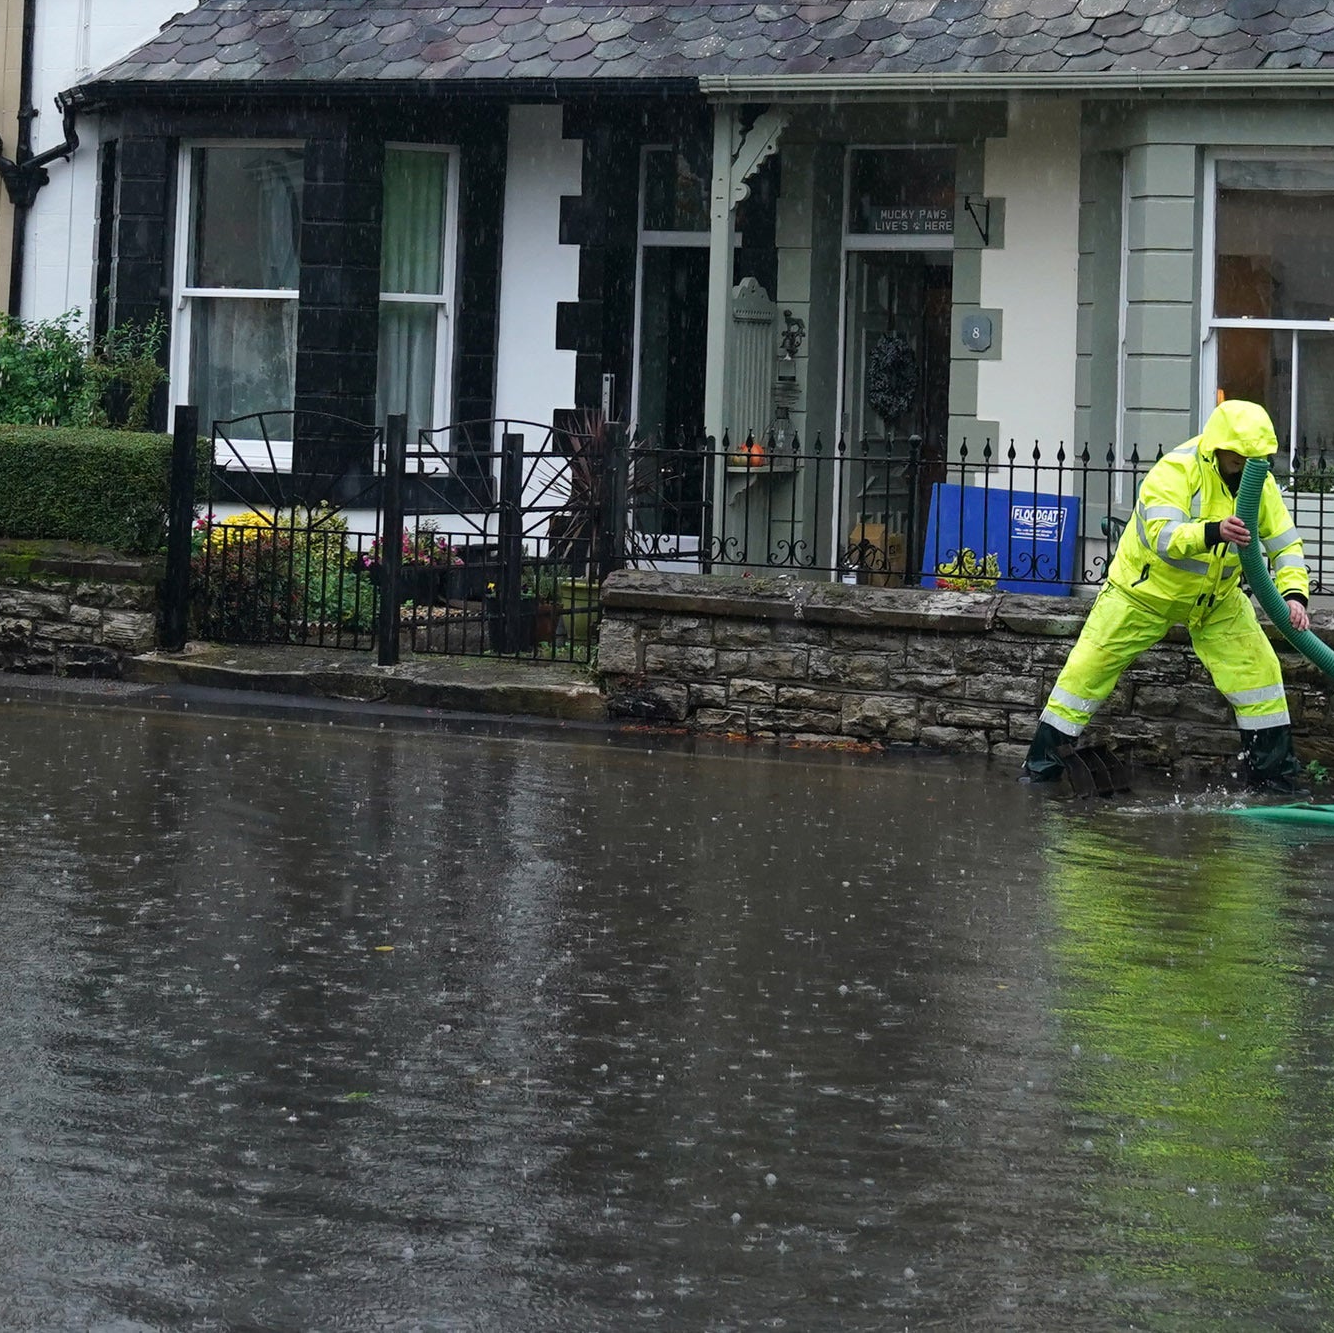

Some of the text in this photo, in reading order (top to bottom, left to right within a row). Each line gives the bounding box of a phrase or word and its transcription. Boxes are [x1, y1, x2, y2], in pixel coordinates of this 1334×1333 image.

[880, 209, 947, 219] MUCKY PAWS
[875, 221, 953, 231] LIVE'S HERE
[972, 327, 980, 339] 8
